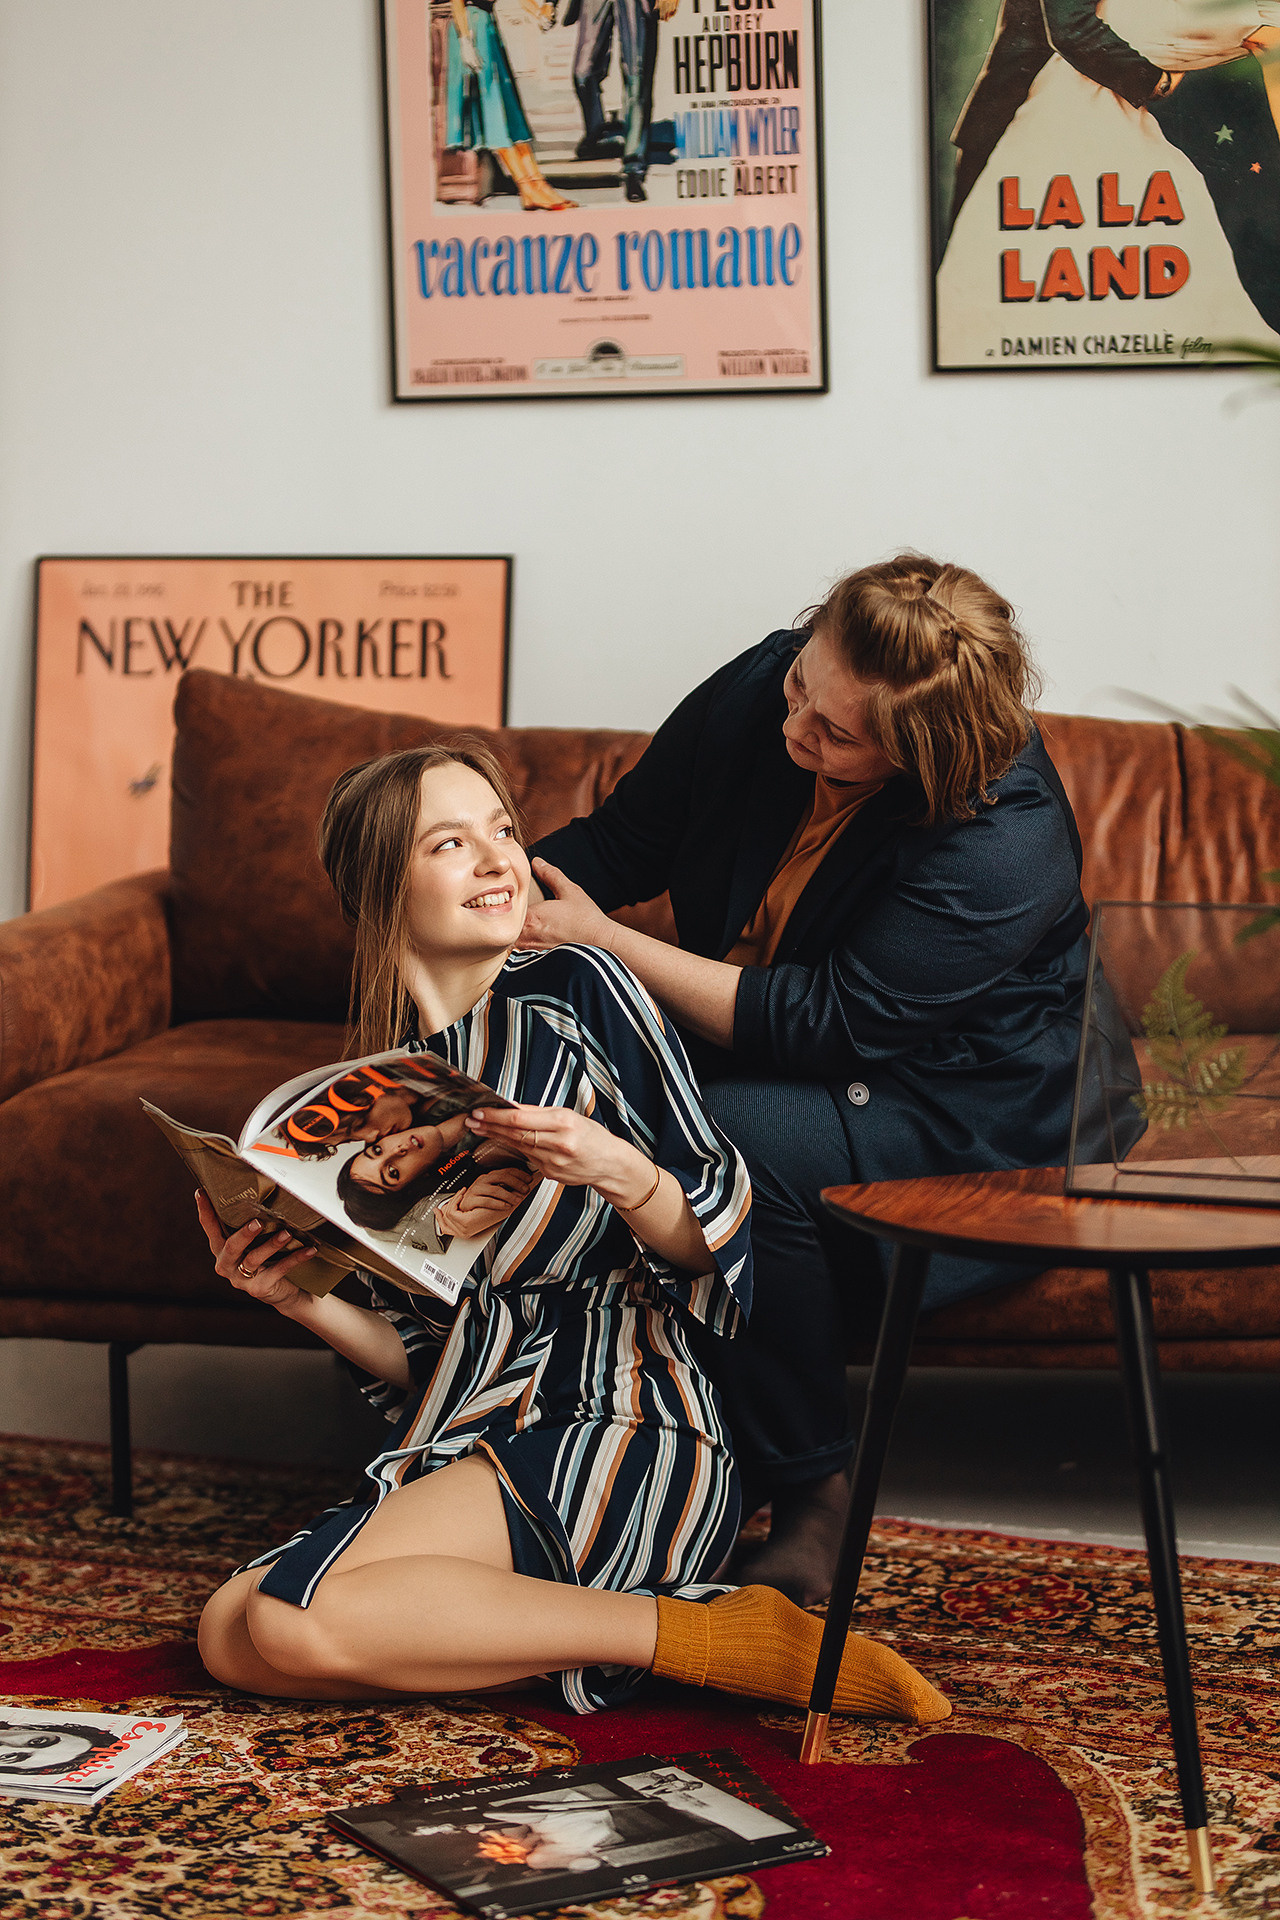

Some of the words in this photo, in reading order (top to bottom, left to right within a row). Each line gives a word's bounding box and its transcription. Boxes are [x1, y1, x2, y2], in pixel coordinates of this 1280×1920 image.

[703, 13, 762, 32] AUDREY
[674, 30, 799, 94] HEPBURN
[745, 106, 800, 156] WYLER
[677, 168, 728, 198] EDDIE
[734, 165, 799, 196] ALBERT
[999, 175, 1085, 231] LA
[1098, 170, 1185, 227] LA
[413, 232, 600, 299] vacanze
[614, 222, 803, 292] romane
[1000, 244, 1190, 302] LAND
[1001, 335, 1076, 356] DAMIEN
[1181, 336, 1212, 359] film
[231, 579, 293, 607] THE
[76, 616, 208, 676] NEW
[217, 615, 452, 680] YORKER
[437, 1150, 471, 1176] Любовь
[54, 1720, 168, 1785] Esquire
[424, 1792, 461, 1804] MAY
[461, 1779, 531, 1796] IMELDA
